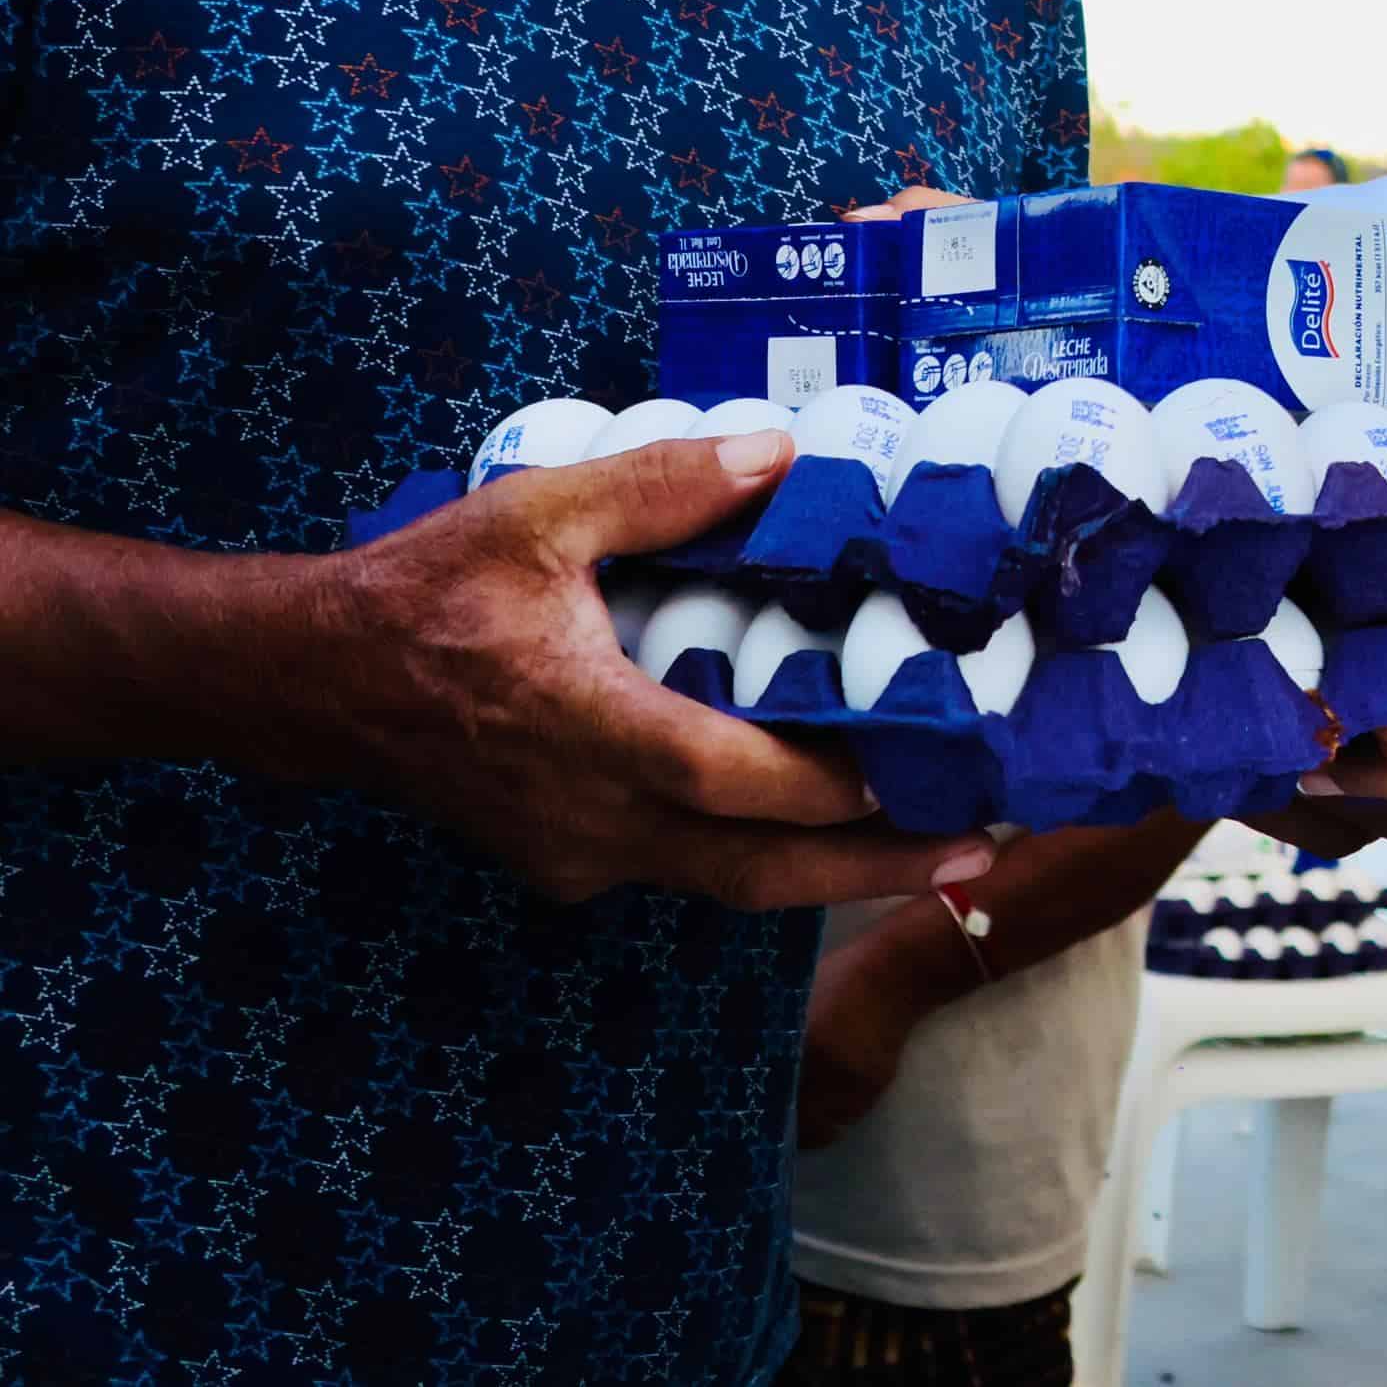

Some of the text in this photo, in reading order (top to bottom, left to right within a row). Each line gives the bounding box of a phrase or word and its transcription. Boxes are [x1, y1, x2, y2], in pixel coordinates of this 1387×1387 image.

[668, 249, 749, 278] Descremada
[688, 271, 725, 288] LECHE
[1301, 272, 1321, 349] Delité
[1353, 234, 1363, 388] DECLARACIÓN NUTRIMENTAL
[1052, 337, 1092, 358] LECHE
[1023, 348, 1109, 380] Descremada
